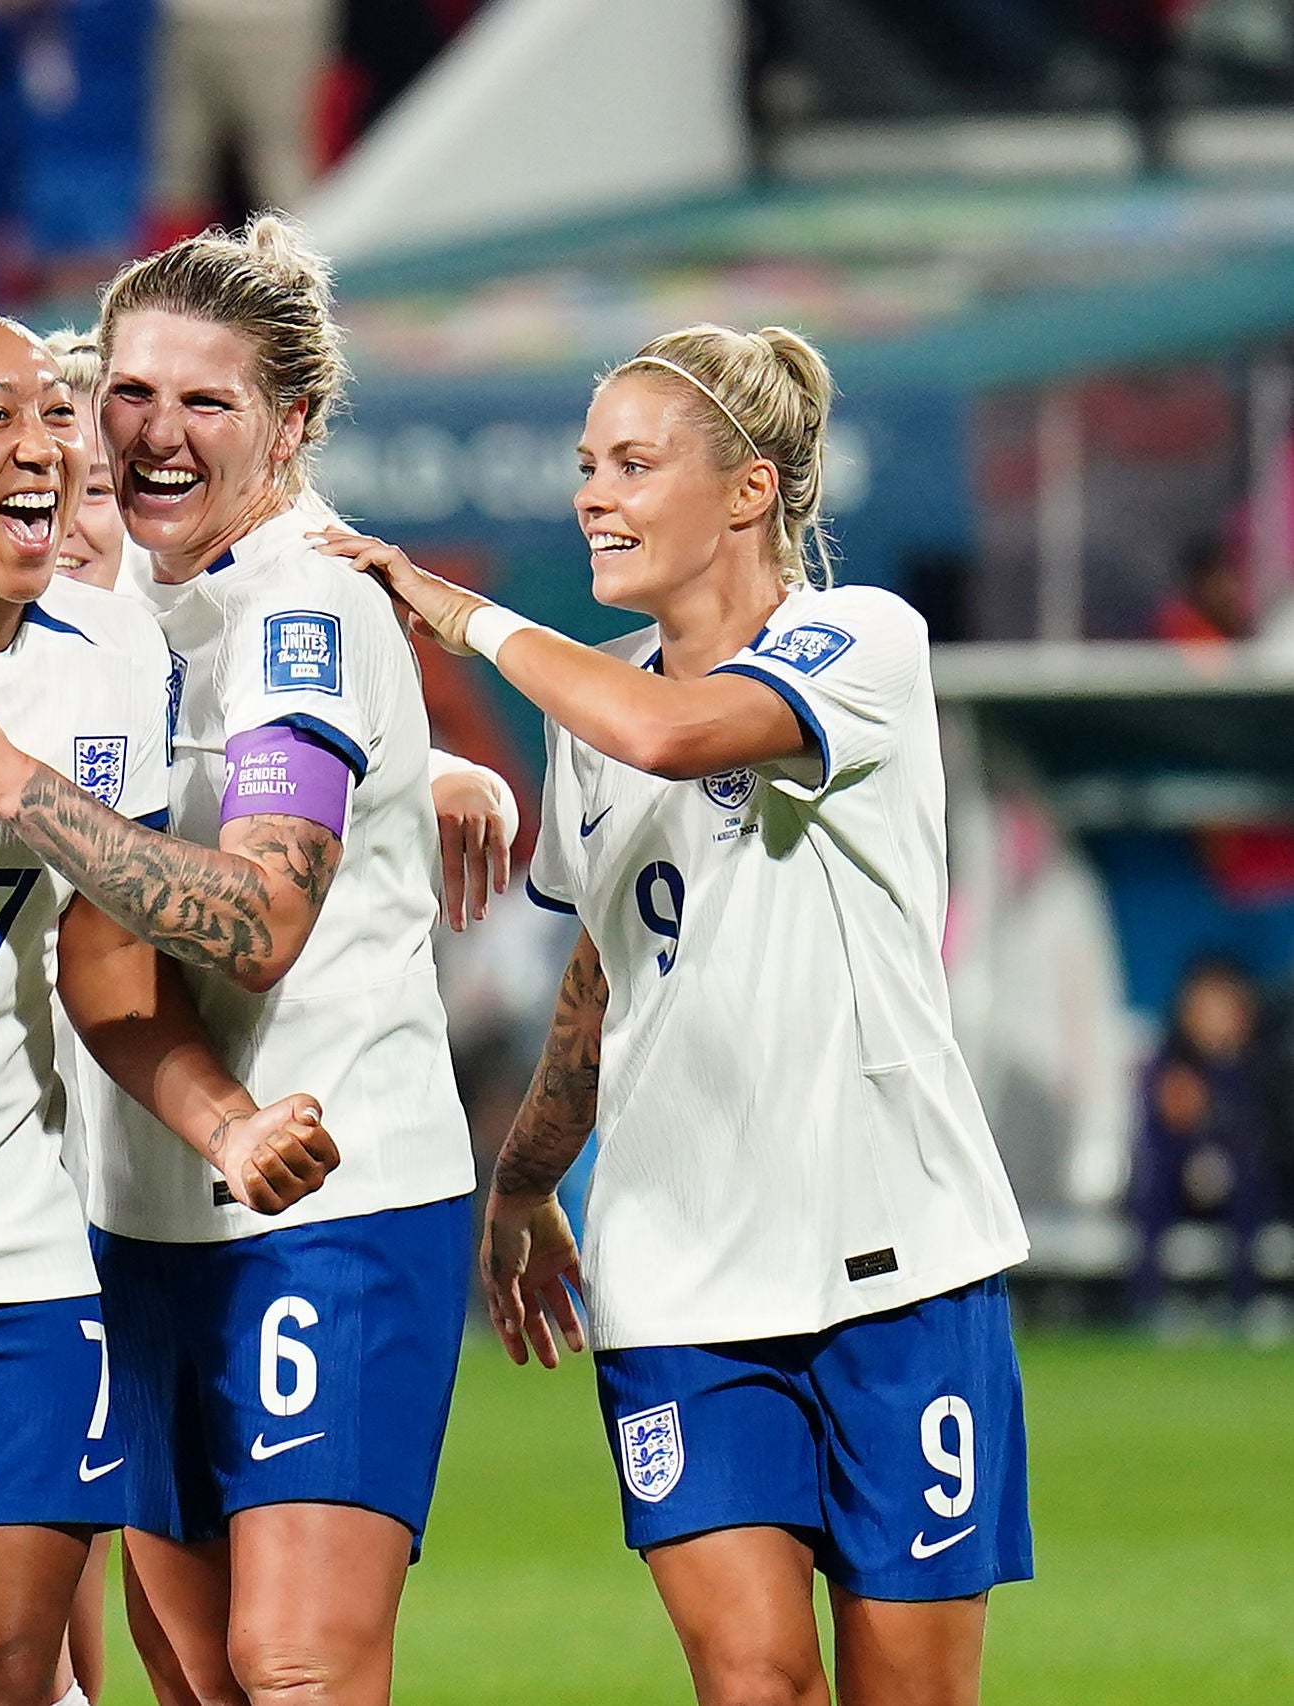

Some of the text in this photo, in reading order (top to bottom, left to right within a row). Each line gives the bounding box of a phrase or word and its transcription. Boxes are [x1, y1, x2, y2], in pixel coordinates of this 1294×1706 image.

[280, 622, 327, 635] FOOTBALL
[280, 634, 328, 651] UNITES
[239, 767, 286, 781] GENDER
[237, 781, 297, 796] EQUALITY
[635, 860, 686, 978] 9
[259, 1295, 319, 1417] 6
[920, 1394, 976, 1518] 9
